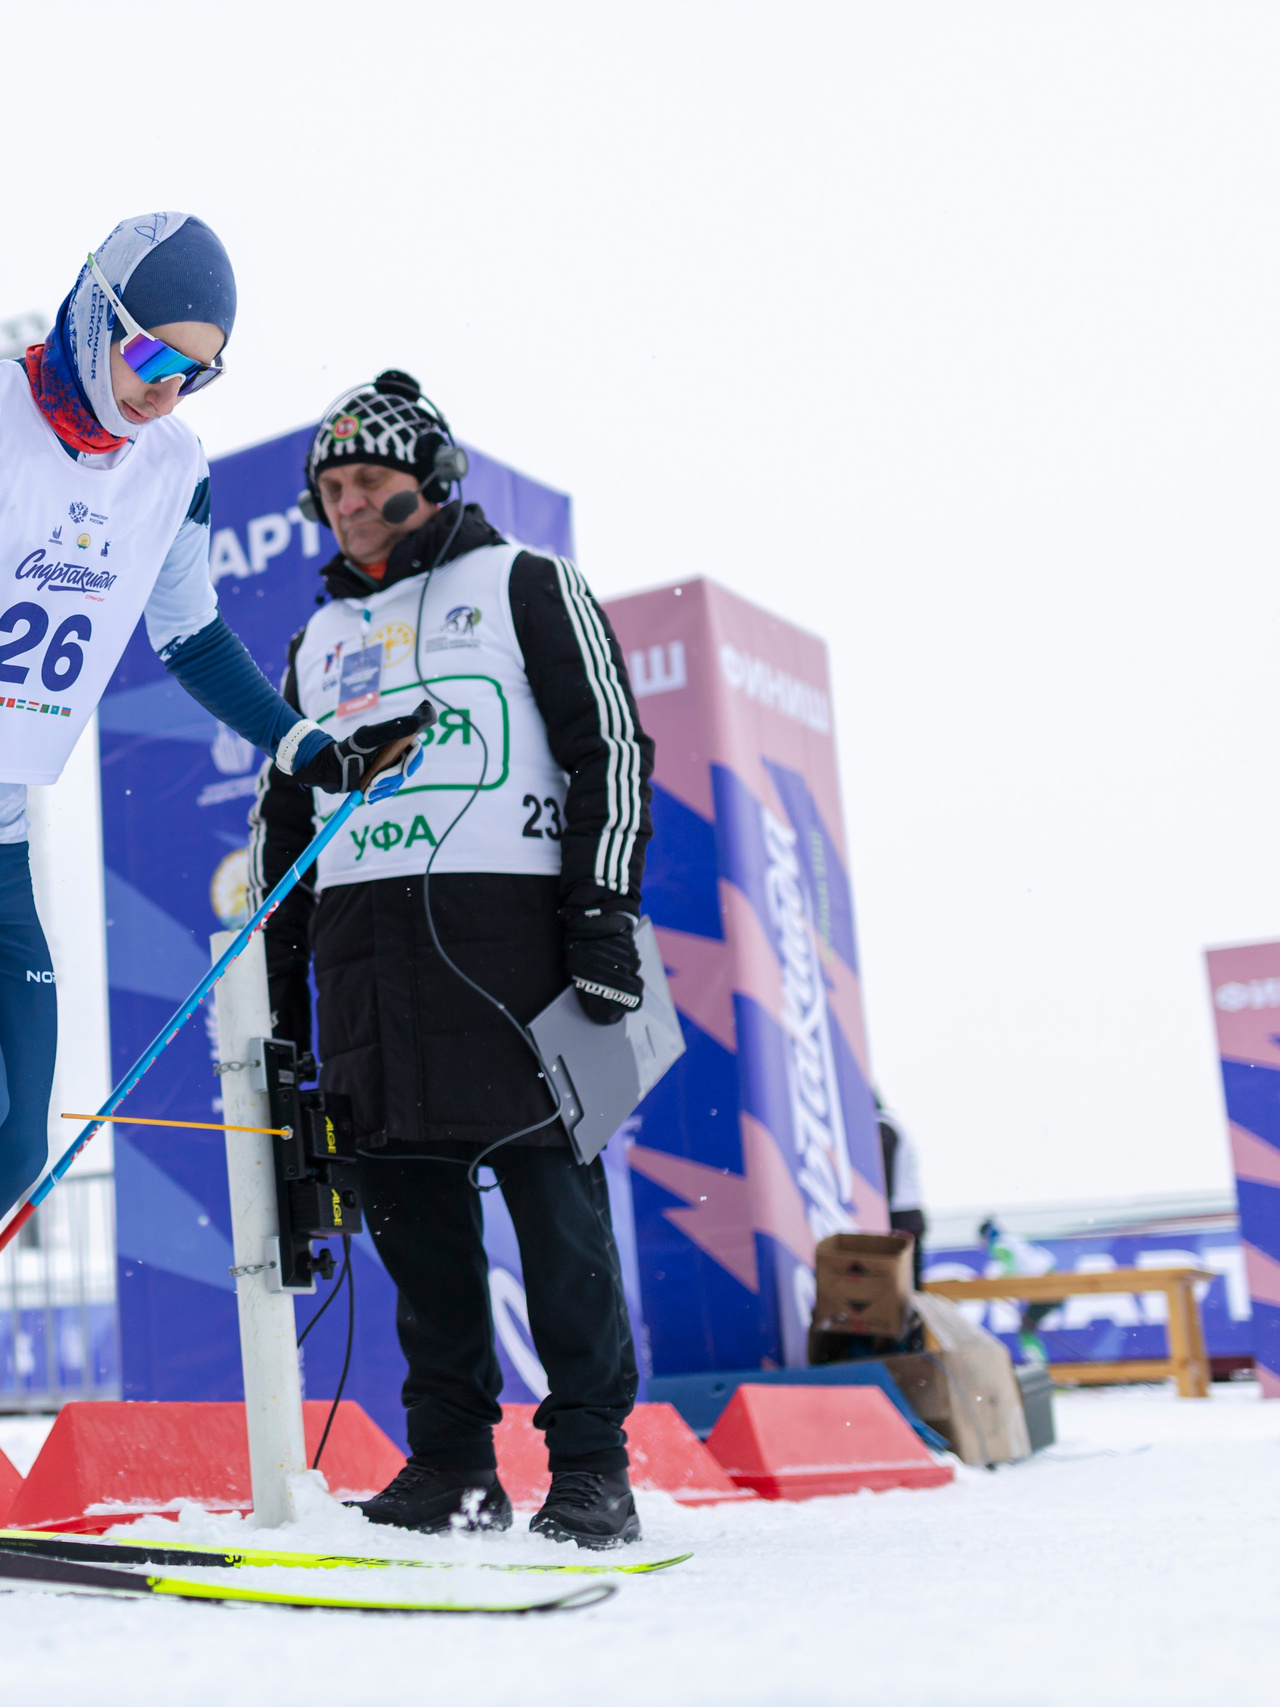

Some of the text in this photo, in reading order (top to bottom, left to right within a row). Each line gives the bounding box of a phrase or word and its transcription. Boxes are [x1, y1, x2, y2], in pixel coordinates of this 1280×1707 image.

[86, 283, 99, 349] LEGKOV
[15, 548, 117, 592] Спартакиада
[721, 643, 830, 734] ФИНИШ
[350, 815, 438, 861] УФА
[325, 1116, 336, 1154] ALGE
[331, 1188, 342, 1226] ALGE
